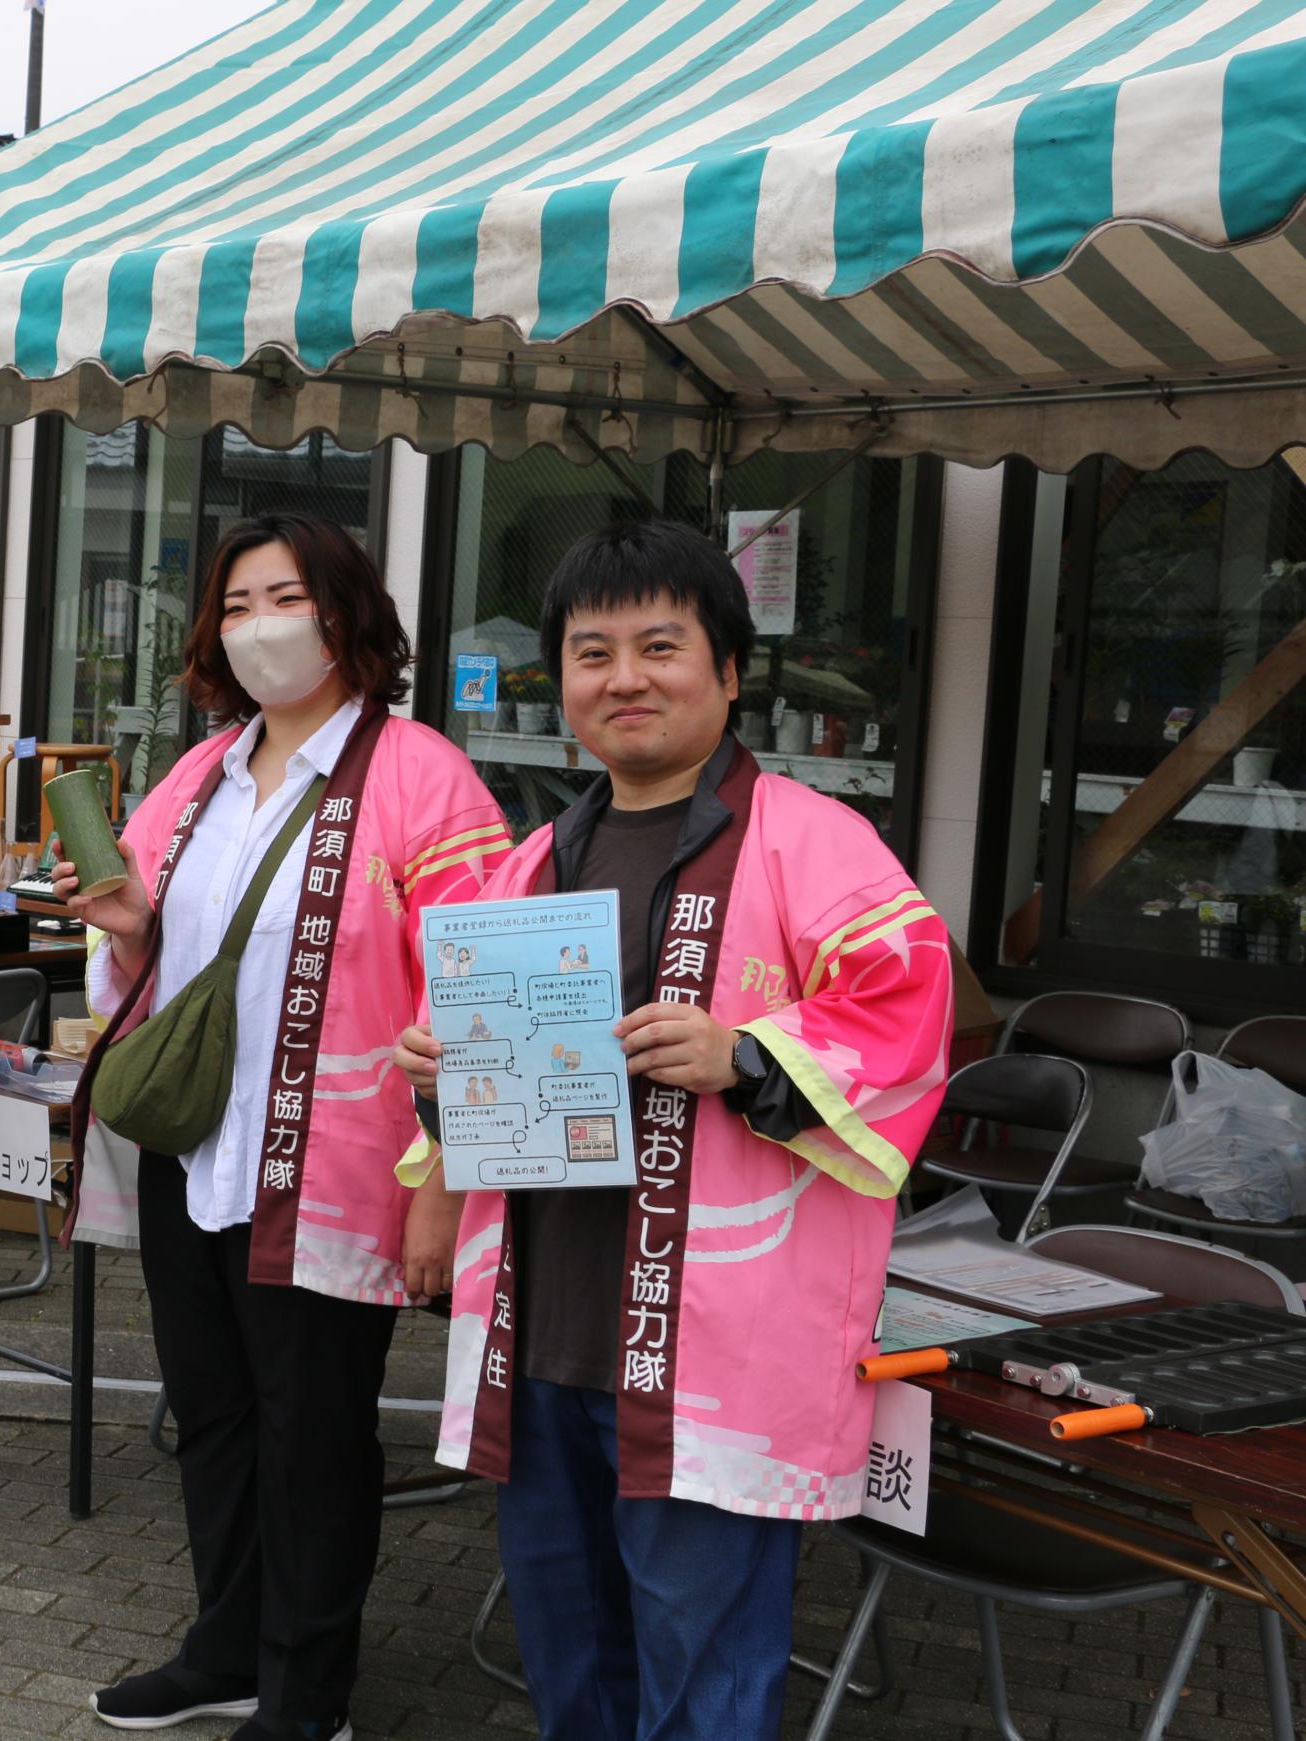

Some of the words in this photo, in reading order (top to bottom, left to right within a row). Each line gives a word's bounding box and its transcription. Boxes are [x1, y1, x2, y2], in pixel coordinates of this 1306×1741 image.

[263, 913, 331, 1191] 地域おこし協力隊
[865, 1441, 914, 1511] 談
